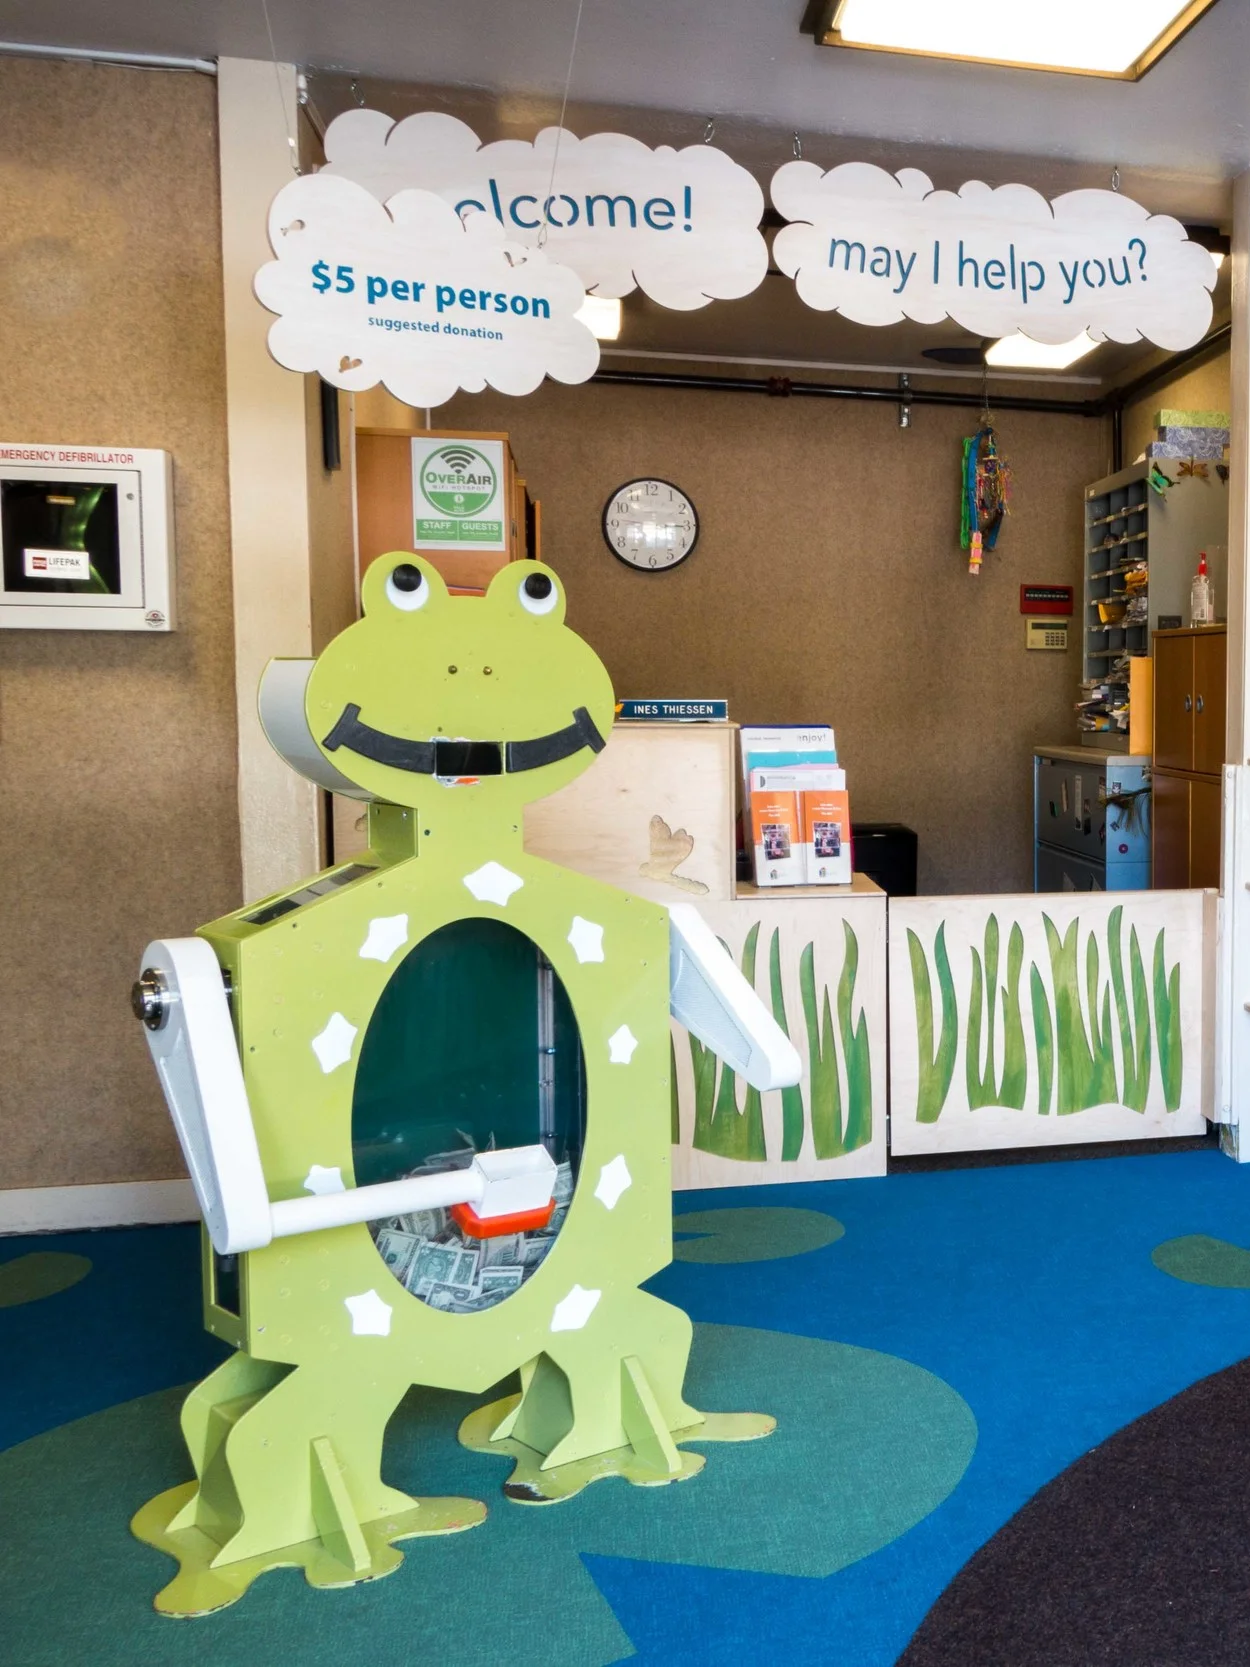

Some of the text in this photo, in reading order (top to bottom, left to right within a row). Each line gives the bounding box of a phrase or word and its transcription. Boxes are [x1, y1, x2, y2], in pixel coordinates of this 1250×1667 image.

[454, 178, 693, 232] lcome!
[828, 237, 1148, 304] may I help you?
[311, 259, 551, 319] $5 per person
[368, 317, 504, 340] suggested donation
[0, 449, 134, 464] MERGENCY DEFIBRILLATOR
[644, 484, 659, 496] 12
[616, 502, 629, 514] 10
[678, 503, 686, 515] 2
[423, 521, 498, 531] STAFF GUESTS
[611, 520, 620, 530] 9
[683, 520, 691, 532] 3
[617, 536, 626, 548] 8
[631, 549, 638, 560] 7
[666, 548, 674, 561] 5
[49, 557, 81, 567] LIFEPAK
[648, 555, 657, 567] 6
[633, 705, 714, 715] INES THIESSEN
